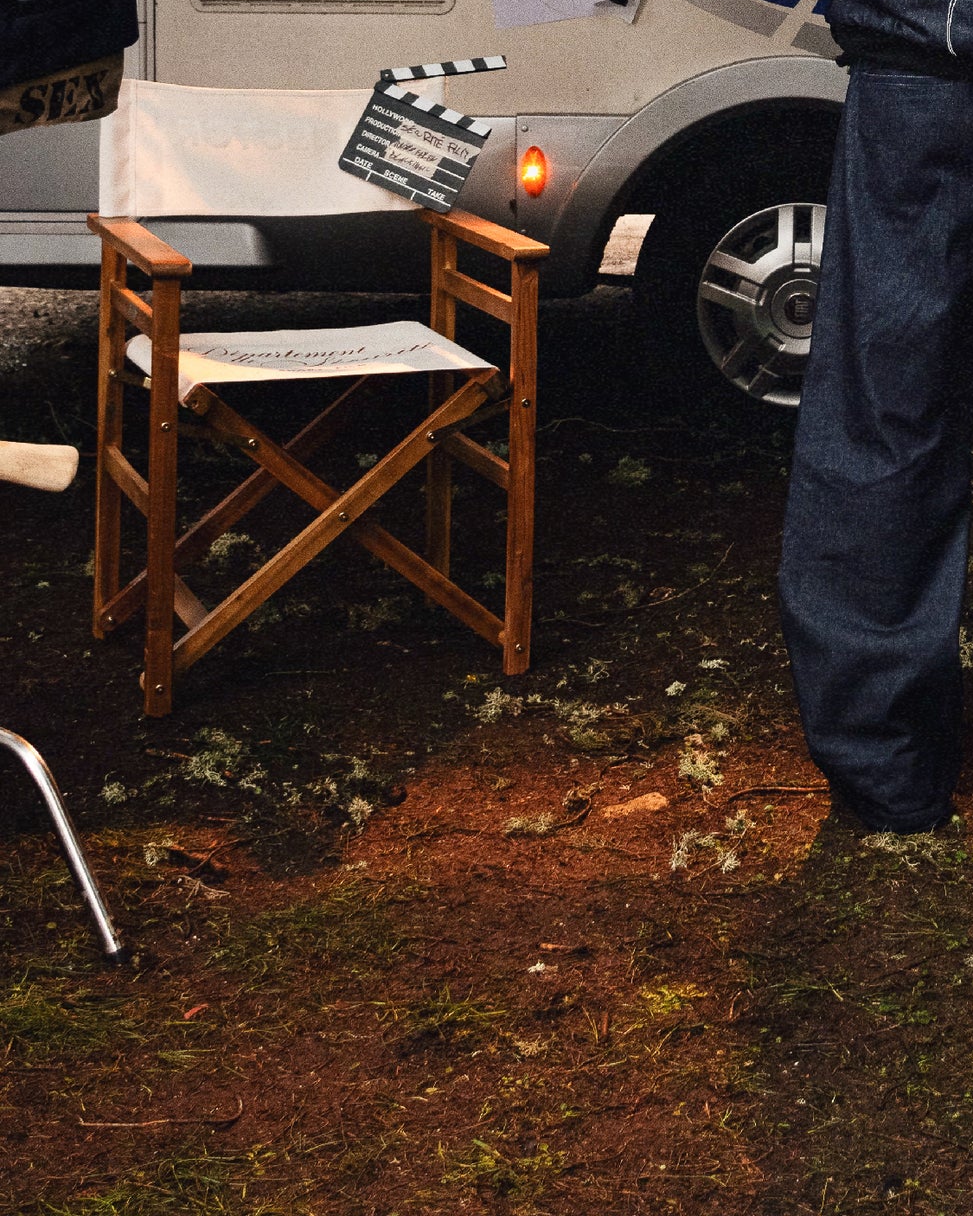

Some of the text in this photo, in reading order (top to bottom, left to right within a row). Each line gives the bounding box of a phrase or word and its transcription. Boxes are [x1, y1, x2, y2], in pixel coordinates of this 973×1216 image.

[361, 130, 391, 148] DIRECTOR
[356, 143, 380, 159] CAMERA
[354, 156, 373, 170] DATE
[384, 170, 409, 184] SCENE
[427, 188, 446, 201] TAKE
